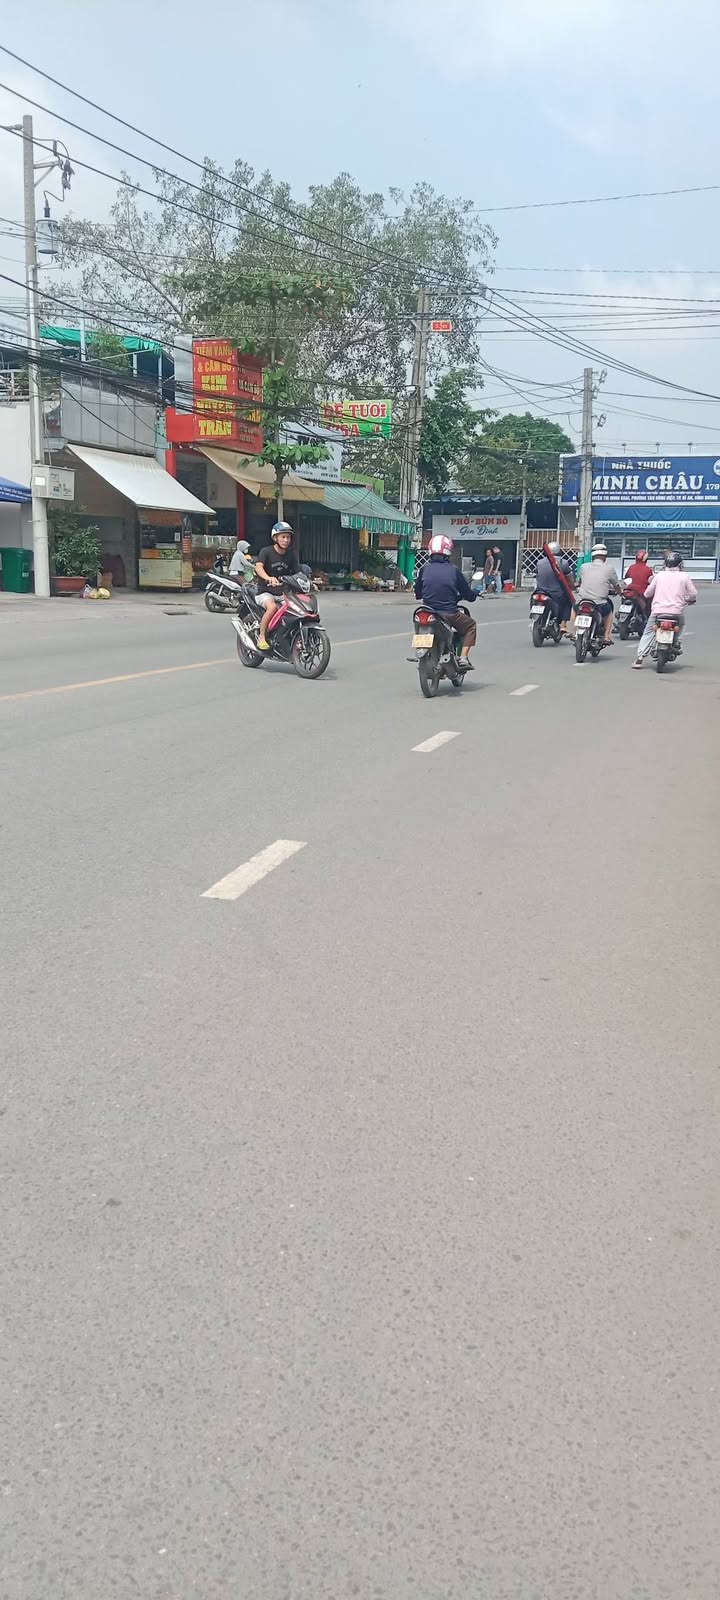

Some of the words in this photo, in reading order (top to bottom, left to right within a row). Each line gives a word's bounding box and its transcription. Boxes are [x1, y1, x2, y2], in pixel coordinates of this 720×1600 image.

[197, 362, 204, 373] &
[592, 475, 640, 491] MINH
[645, 472, 704, 491] CHÂU
